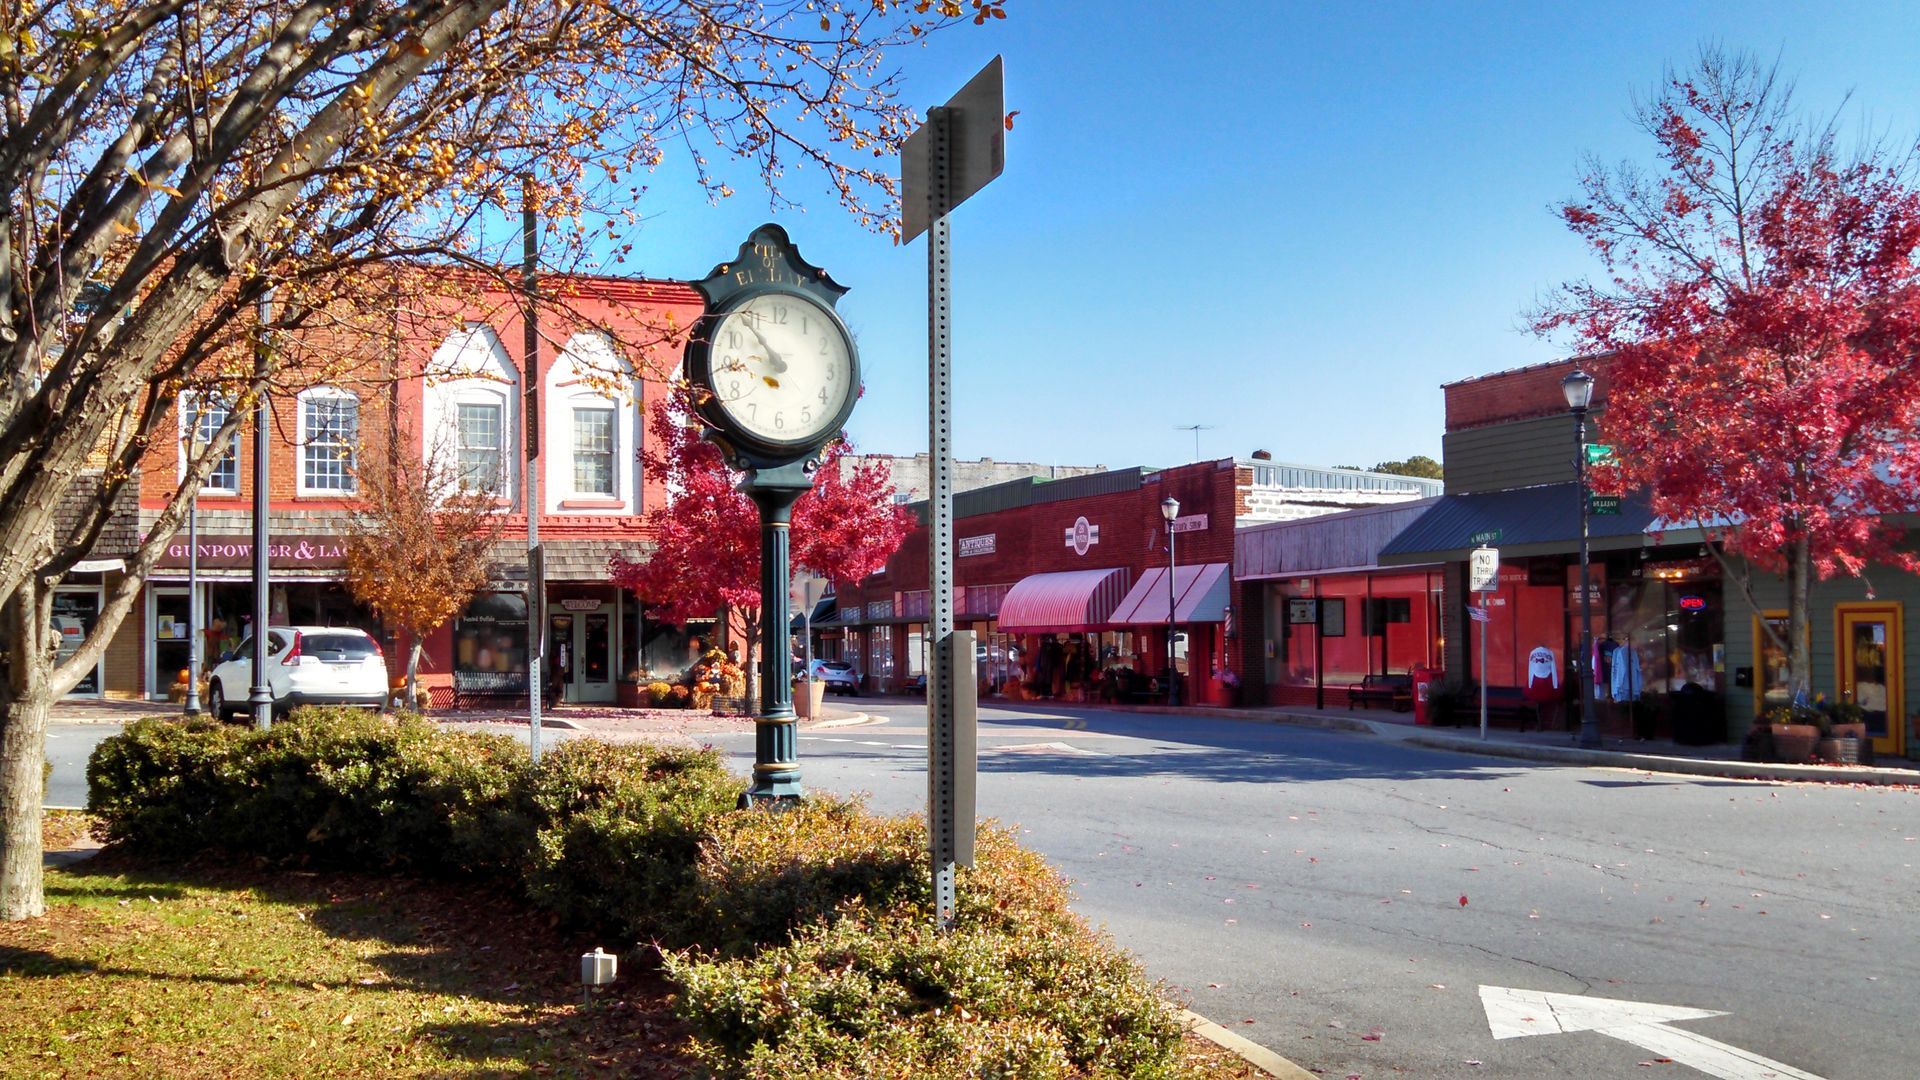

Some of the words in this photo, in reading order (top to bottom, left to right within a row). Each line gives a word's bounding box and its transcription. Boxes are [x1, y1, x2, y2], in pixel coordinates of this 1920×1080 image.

[754, 244, 782, 258] CIT
[735, 269, 806, 286] ELIJY
[772, 307, 788, 325] 12
[801, 317, 809, 335] 1
[728, 331, 743, 349] 10
[819, 337, 829, 356] 2
[826, 362, 835, 381] 3
[729, 380, 741, 399] 8
[817, 386, 829, 405] 4
[747, 403, 757, 421] 7
[774, 411, 784, 430] 6
[801, 405, 811, 424] 5
[961, 535, 994, 549] ANTIQUES
[1475, 532, 1491, 542] MAIN
[1491, 532, 1497, 540] ST
[169, 544, 291, 558] GUNPOWER
[294, 540, 316, 560] &
[1479, 554, 1491, 566] NO
[1476, 566, 1494, 576] THRU
[1473, 576, 1497, 586] TRUCKS
[1681, 600, 1703, 608] OPEN
